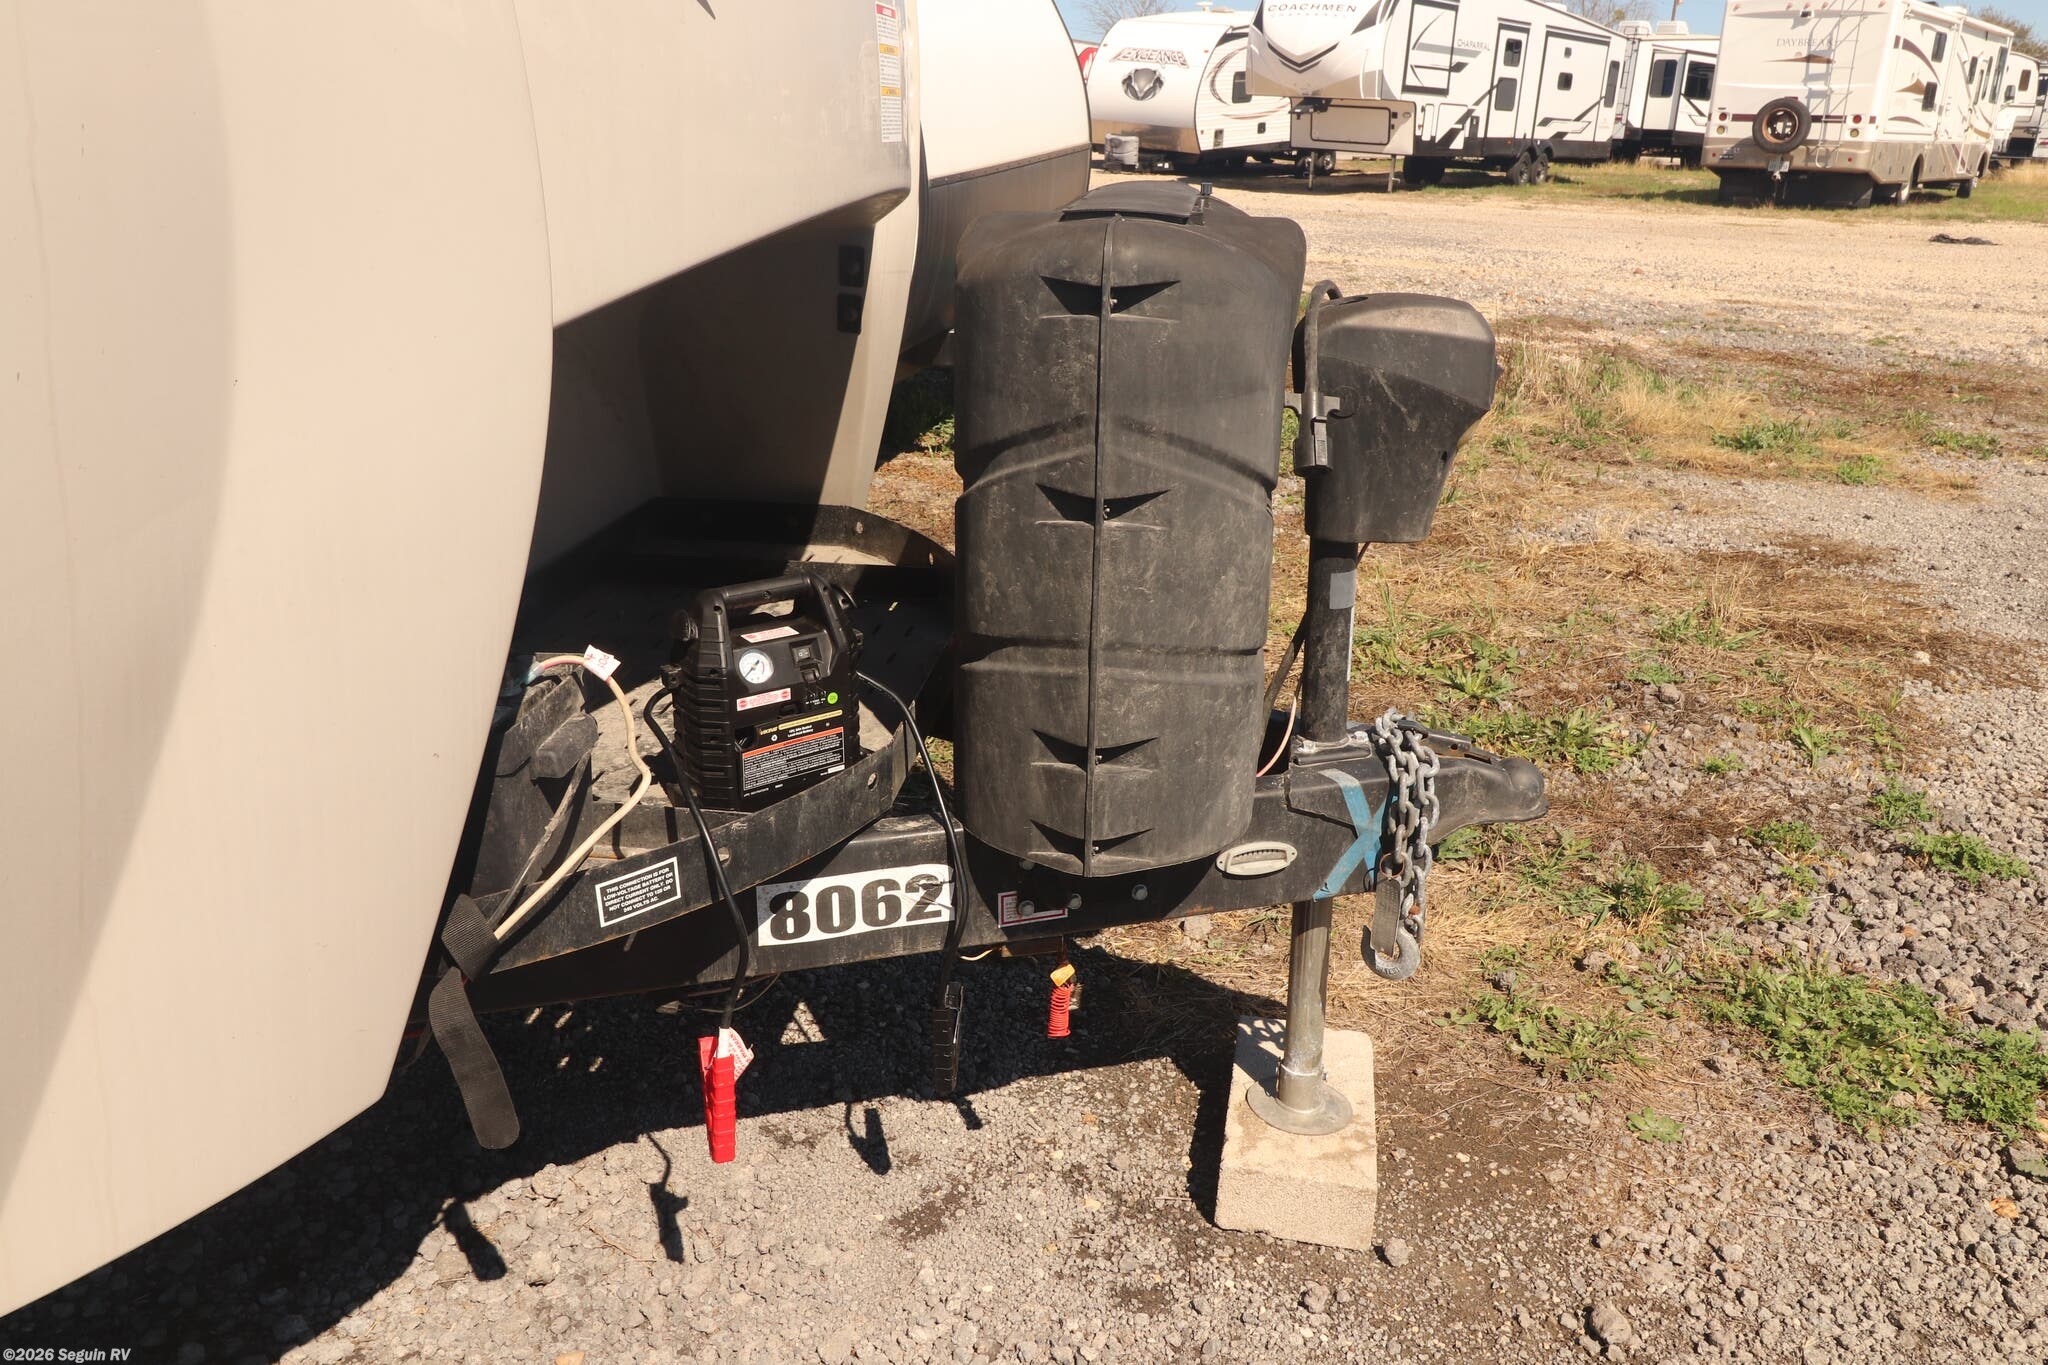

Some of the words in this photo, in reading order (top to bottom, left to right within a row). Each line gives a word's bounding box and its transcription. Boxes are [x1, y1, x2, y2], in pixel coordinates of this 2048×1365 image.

[1267, 3, 1357, 12] COACHMEN
[603, 884, 642, 901] LOW-VOLTAGE
[641, 875, 665, 888] BATTERY
[619, 873, 653, 889] CONNECTION
[658, 867, 670, 876] FOR
[605, 898, 625, 907] DIRECT
[624, 887, 650, 900] CURRENT
[609, 904, 621, 912] NOT
[620, 895, 646, 908] CONNECT
[633, 900, 650, 909] VOLTS
[769, 874, 943, 941] 8062
